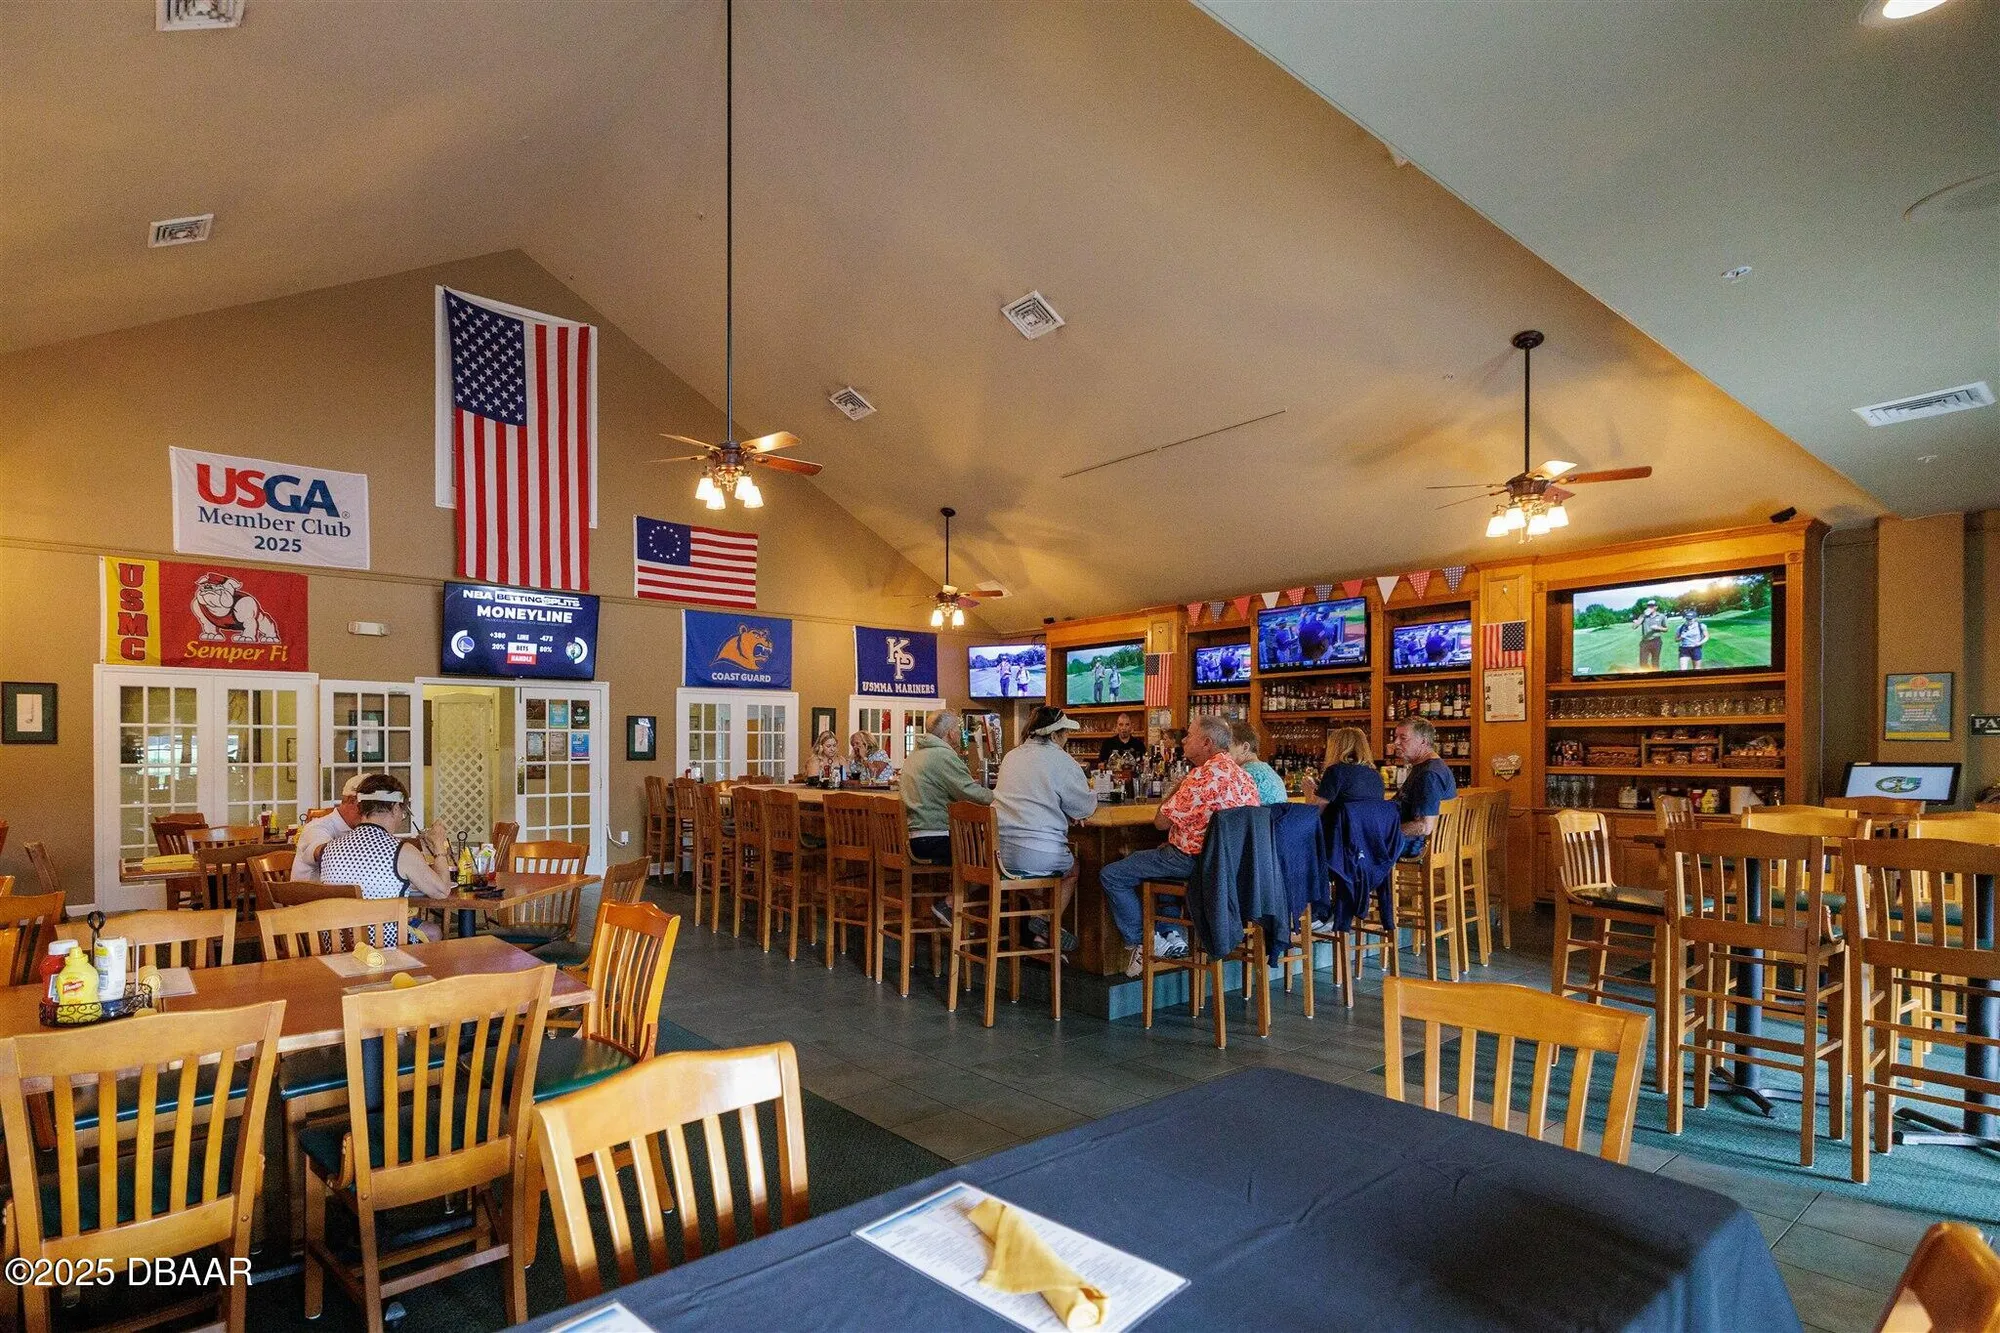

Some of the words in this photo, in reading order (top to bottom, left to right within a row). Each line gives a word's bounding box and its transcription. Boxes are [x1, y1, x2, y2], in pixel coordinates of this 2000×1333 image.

[196, 463, 341, 518] USGA
[197, 505, 296, 532] Member
[301, 518, 351, 538] Club
[254, 535, 303, 553] 2025
[462, 589, 494, 600] NBA
[496, 593, 543, 604] BETTING
[118, 562, 149, 661] USMC
[476, 604, 573, 624] MONEYLINE
[184, 640, 265, 664] Semper
[269, 645, 289, 662] Fi
[711, 672, 740, 681] COAST
[740, 673, 771, 683] GUARD
[862, 681, 893, 693] USMMA
[895, 683, 935, 694] MARINERS
[1974, 718, 2000, 728] PA
